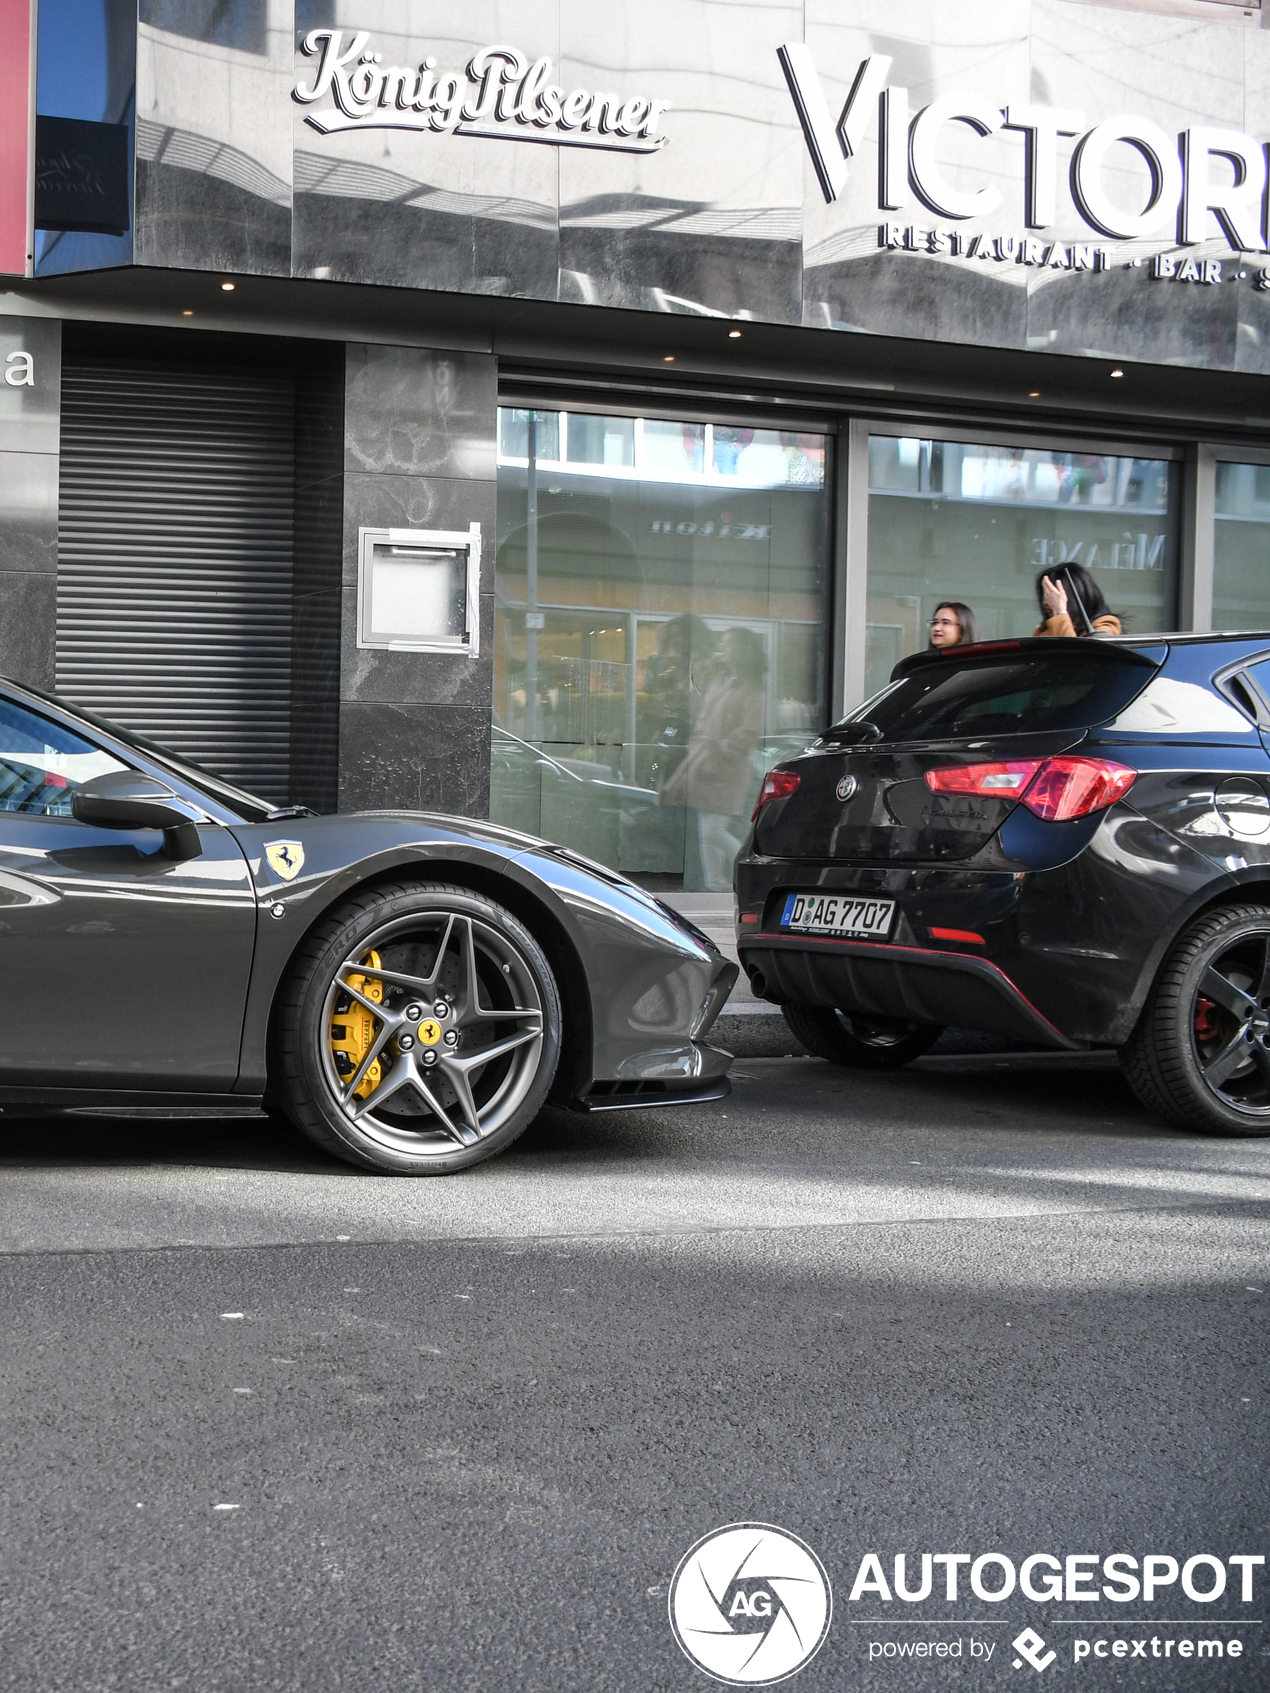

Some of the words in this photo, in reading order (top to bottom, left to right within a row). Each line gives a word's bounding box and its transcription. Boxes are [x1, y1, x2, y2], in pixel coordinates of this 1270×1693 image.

[291, 28, 468, 133] König
[460, 45, 673, 139] Pilsener
[776, 42, 1270, 254] VICTOR
[878, 220, 1115, 273] RESTAURANT
[1154, 253, 1222, 284] BAR
[791, 898, 805, 923] D
[812, 899, 838, 925] AG
[840, 900, 891, 930] 7707
